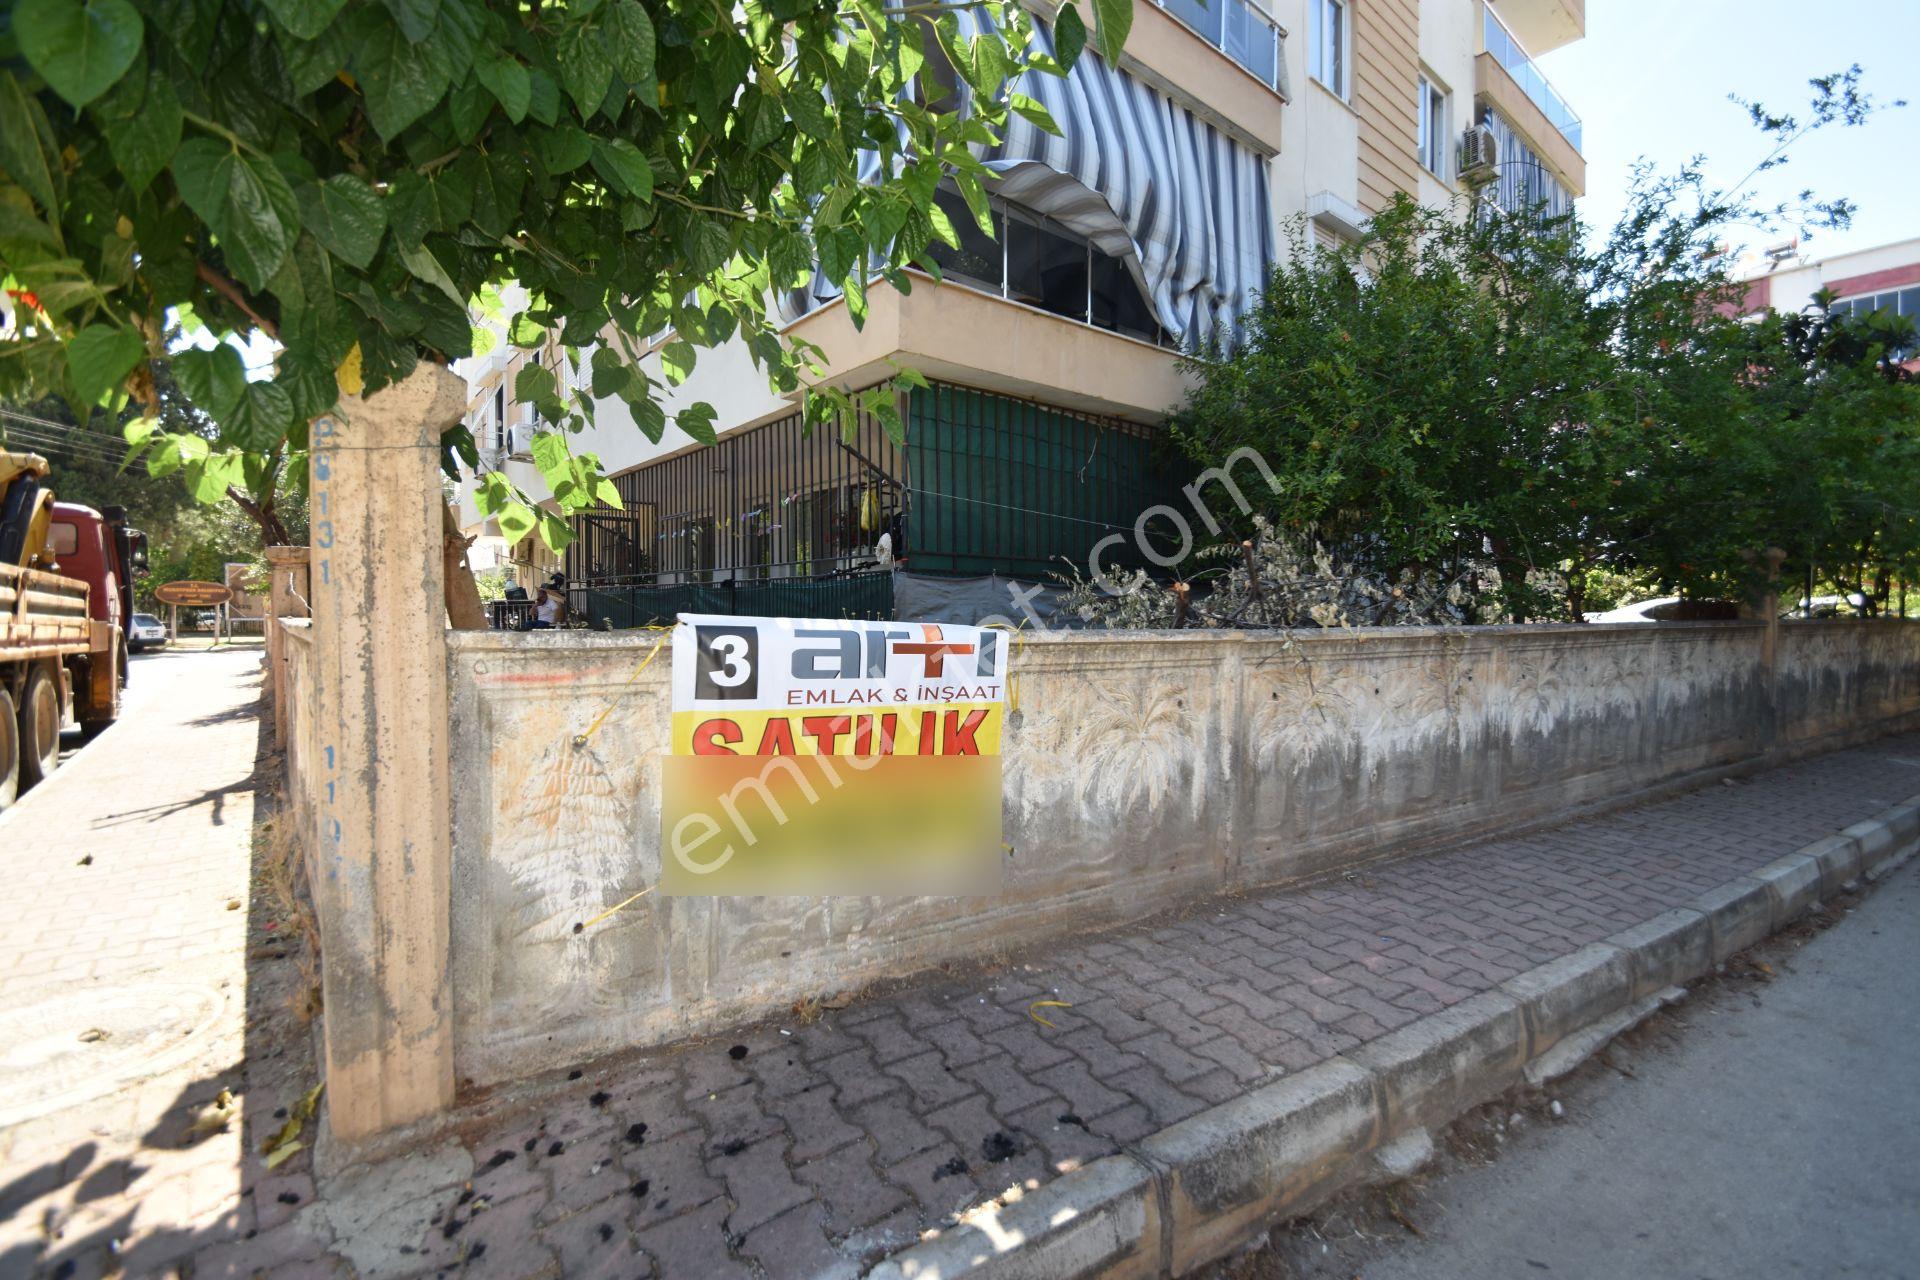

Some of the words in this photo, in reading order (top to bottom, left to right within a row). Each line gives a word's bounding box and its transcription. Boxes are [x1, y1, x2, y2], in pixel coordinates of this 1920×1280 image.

[708, 635, 751, 687] 3
[787, 688, 883, 706] EMLAK
[893, 687, 908, 703] &
[917, 684, 1001, 704] İNŞAAT
